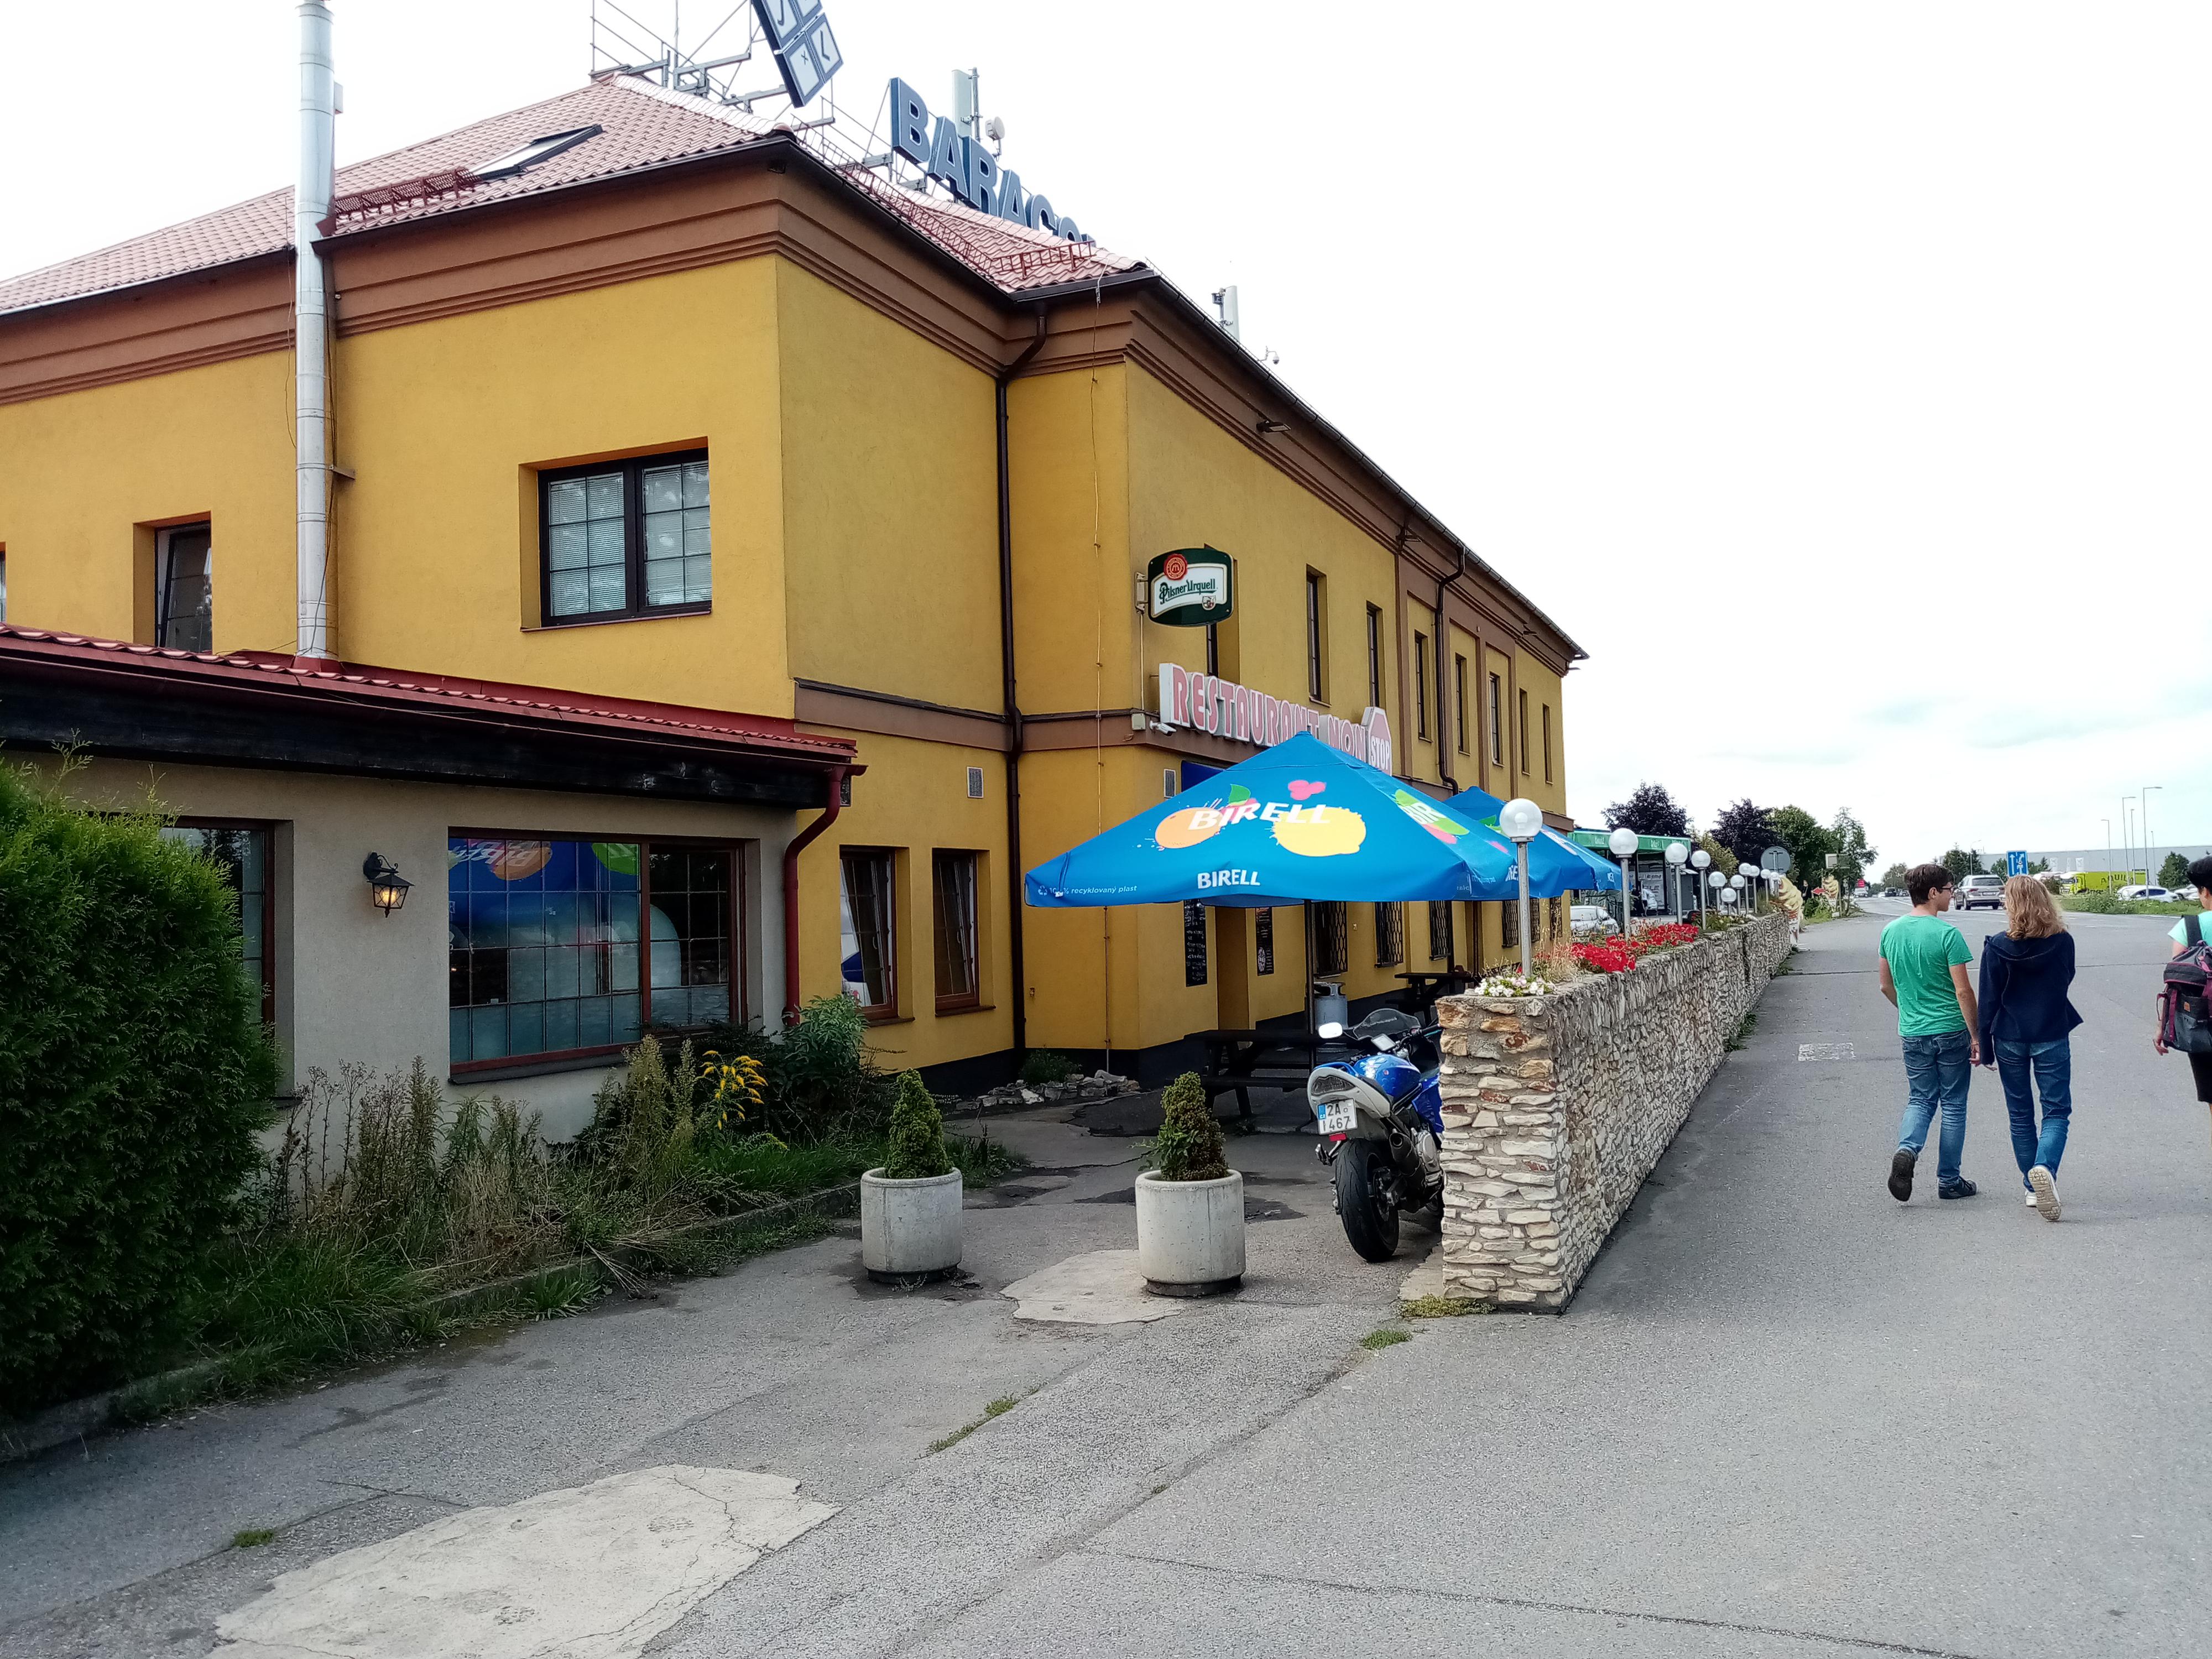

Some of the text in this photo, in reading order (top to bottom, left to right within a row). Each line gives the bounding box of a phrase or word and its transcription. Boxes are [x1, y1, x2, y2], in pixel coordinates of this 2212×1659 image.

[1159, 579, 1215, 604] Pilsner Urquell
[1172, 664, 1390, 770] RESTAURANT NON STOP
[1188, 802, 1331, 831] BIRELL
[1071, 885, 1117, 894] recyklovaný
[1197, 869, 1260, 889] BIRELL
[1327, 1103, 1341, 1117] 2A
